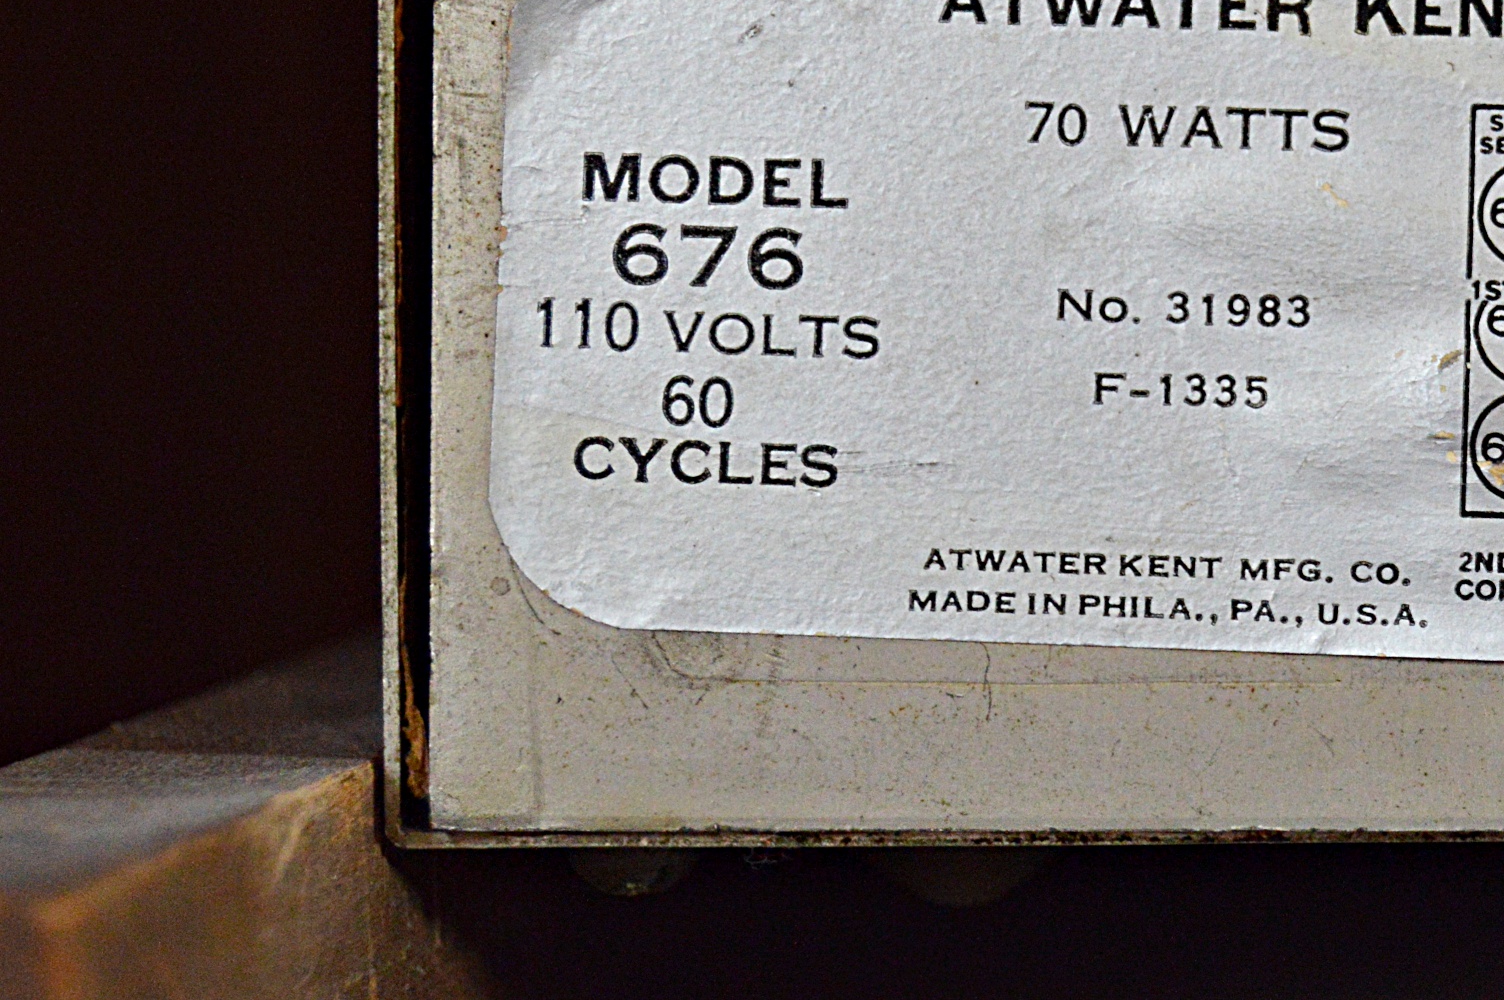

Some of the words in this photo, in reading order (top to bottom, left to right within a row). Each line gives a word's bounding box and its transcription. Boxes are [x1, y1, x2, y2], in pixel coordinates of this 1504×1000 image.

[1024, 100, 1088, 147] 70
[1118, 104, 1350, 153] WATTS
[582, 152, 849, 210] MODEL
[612, 223, 804, 291] 676
[536, 297, 640, 353] 110
[664, 310, 880, 360] VOLTS
[1057, 288, 1141, 325] No.
[1165, 290, 1311, 328] 31983
[661, 374, 734, 429] 60
[1093, 372, 1268, 410] F-1335
[573, 436, 838, 489] CYCLES
[923, 548, 1107, 576] ATWATER
[1119, 554, 1223, 579] KENT
[1240, 558, 1334, 584] MFG.
[1350, 560, 1411, 587] CO.
[908, 589, 1017, 614] MADE
[1027, 592, 1067, 616] IN
[1078, 594, 1218, 626] PHILA.,
[1317, 602, 1427, 629] U.S.A.
